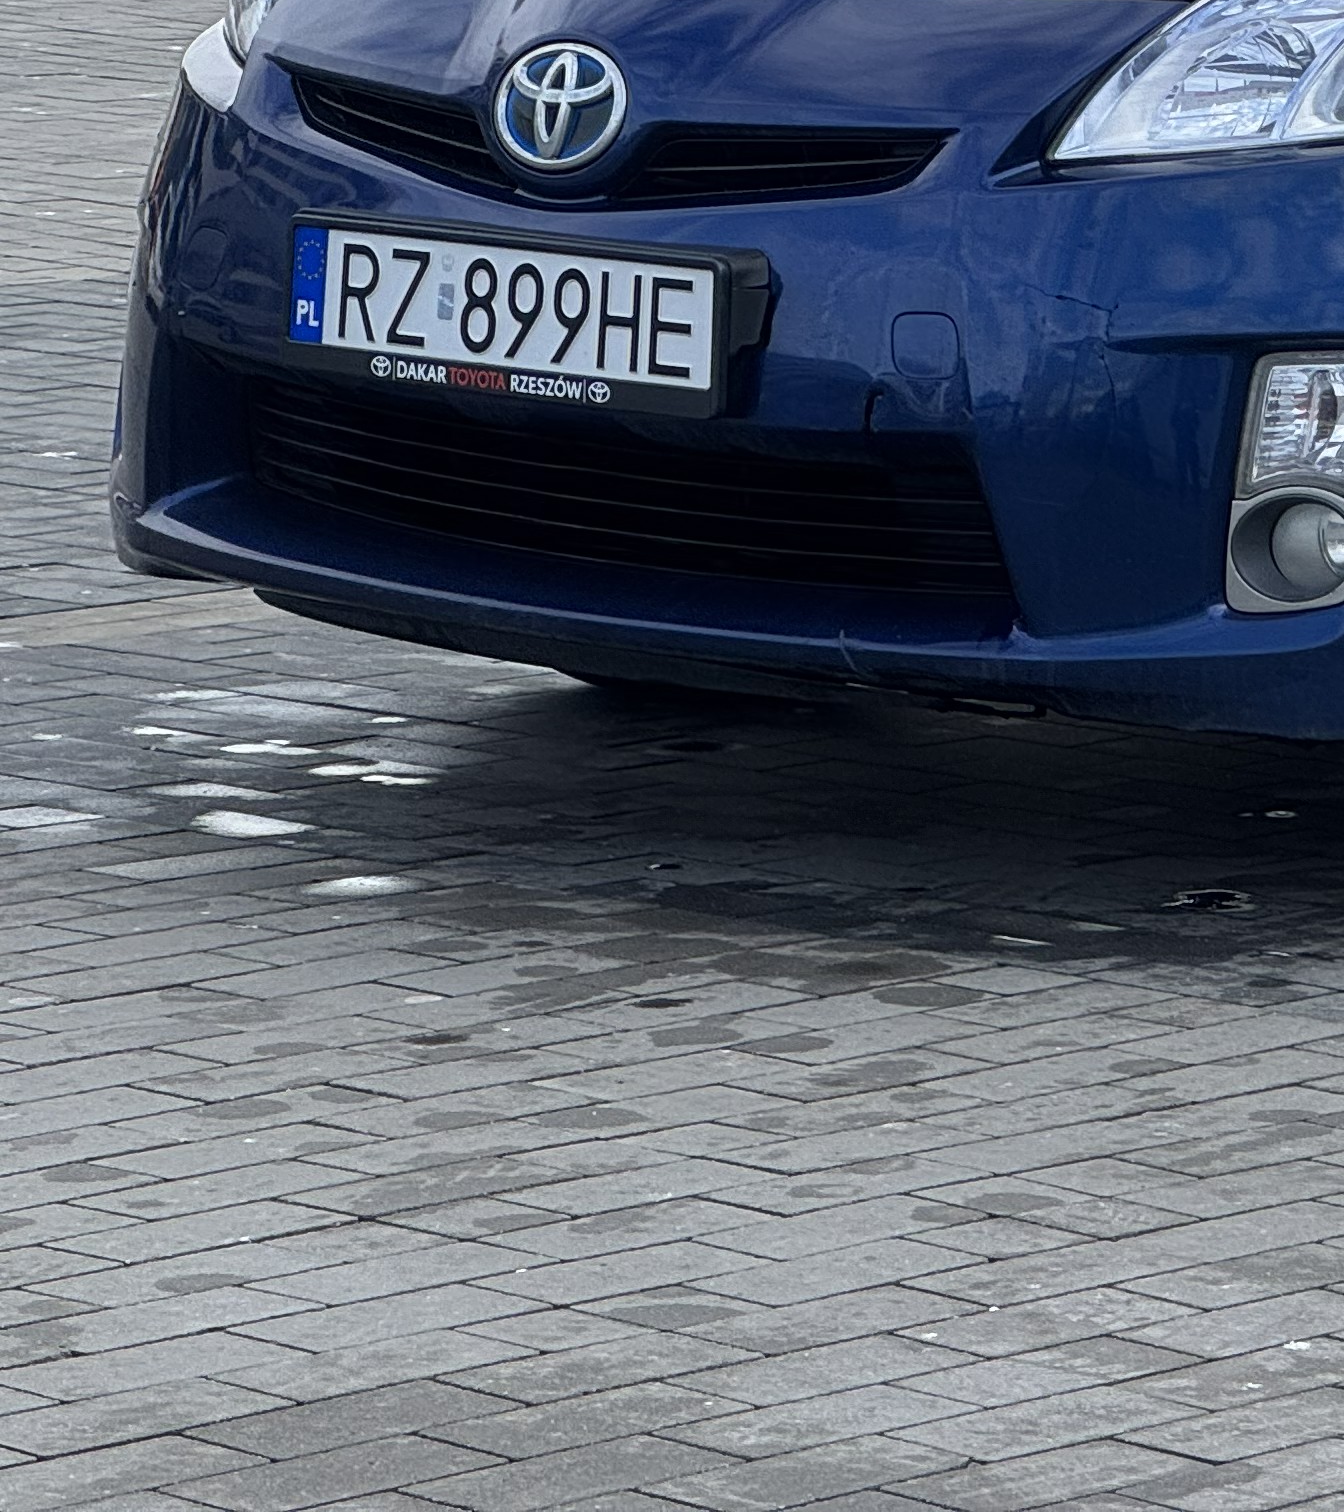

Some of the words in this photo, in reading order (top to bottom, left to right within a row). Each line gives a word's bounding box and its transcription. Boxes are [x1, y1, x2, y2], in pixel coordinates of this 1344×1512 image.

[295, 299, 320, 328] PL
[337, 242, 431, 349] RZ
[460, 257, 694, 380] 899HE
[396, 360, 448, 385] DAKAR
[448, 366, 507, 391] TOYOTA
[509, 372, 582, 400] RZESZÓW
